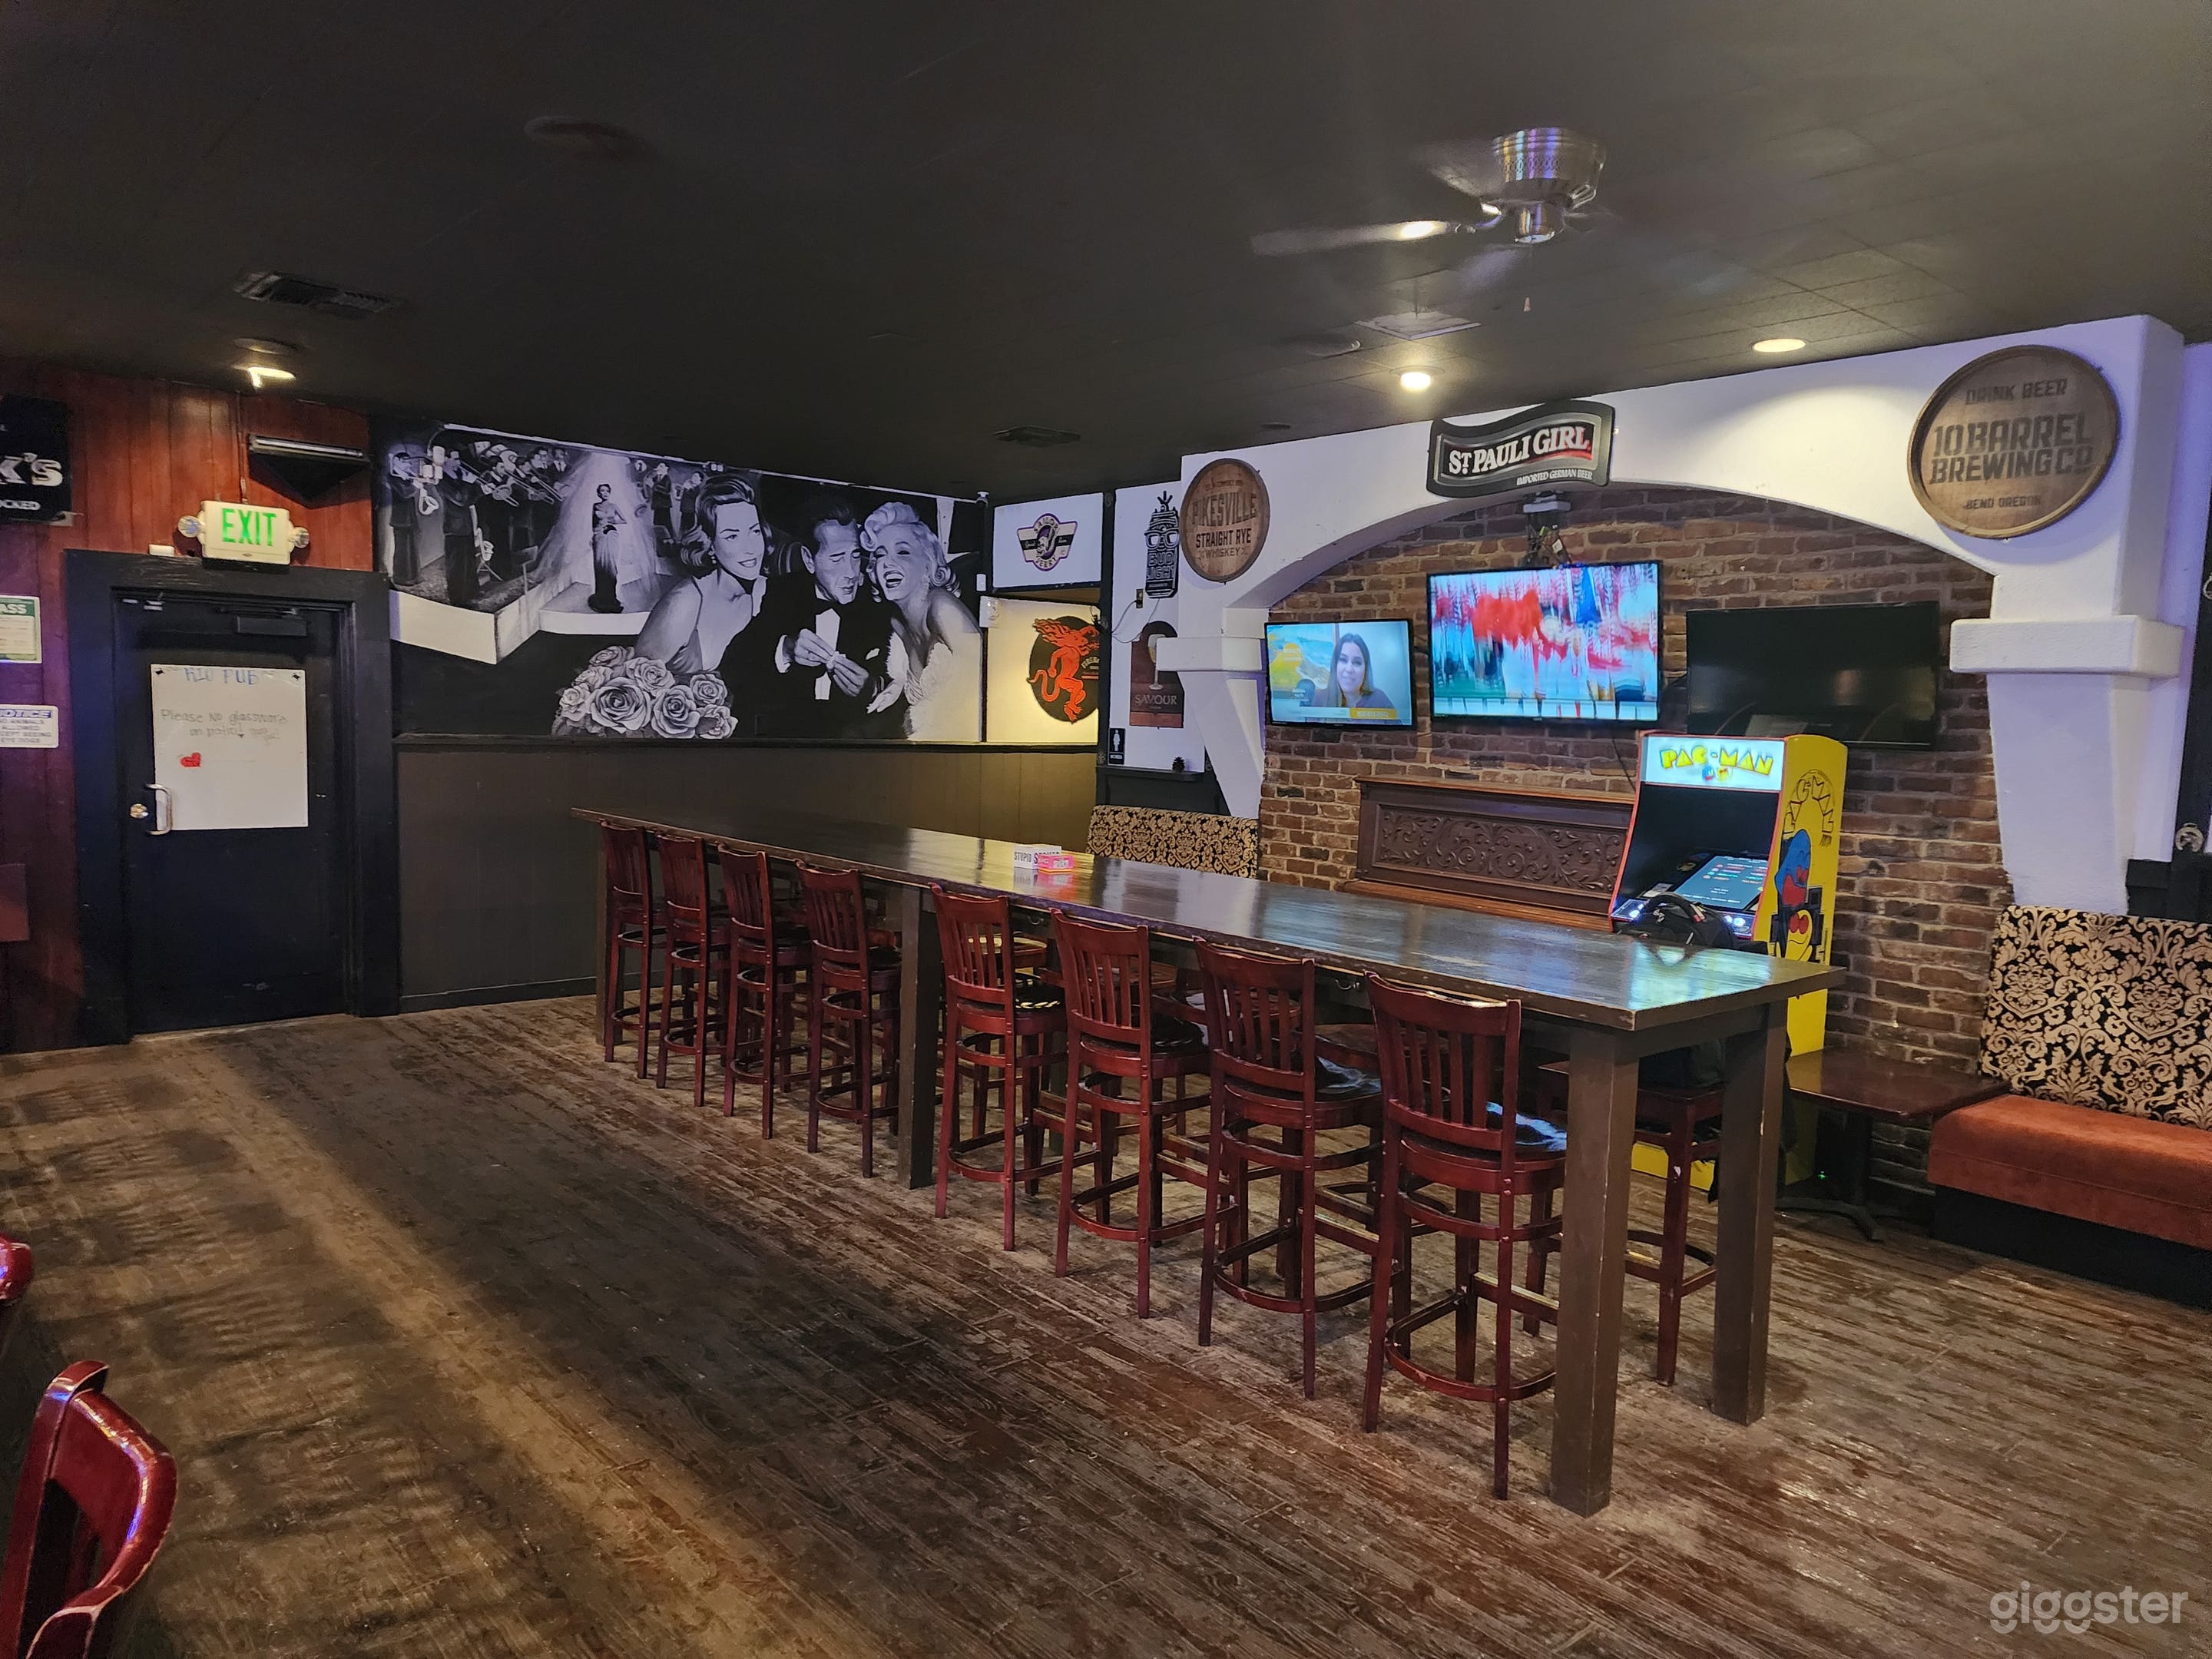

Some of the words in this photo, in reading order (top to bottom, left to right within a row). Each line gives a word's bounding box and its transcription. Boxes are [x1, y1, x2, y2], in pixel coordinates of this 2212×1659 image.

[2022, 379, 2068, 399] BEER
[1472, 435, 1532, 473] PAULI
[1533, 426, 1591, 455] GIRL
[1516, 473, 1549, 485] IMPORTED
[1549, 469, 1577, 481] GERMAN
[1577, 469, 1594, 481] BEER
[1191, 491, 1257, 527] PIKESVILLE
[222, 508, 277, 547] EXIT
[1196, 529, 1234, 548] STRAIGHT
[1235, 528, 1252, 545] RYE
[1148, 551, 1174, 566] BUD
[1205, 546, 1241, 559] WHISKEY
[1134, 694, 1177, 705] SAVOUR
[161, 708, 204, 724] Please
[1660, 743, 1774, 776] PAC-MAN
